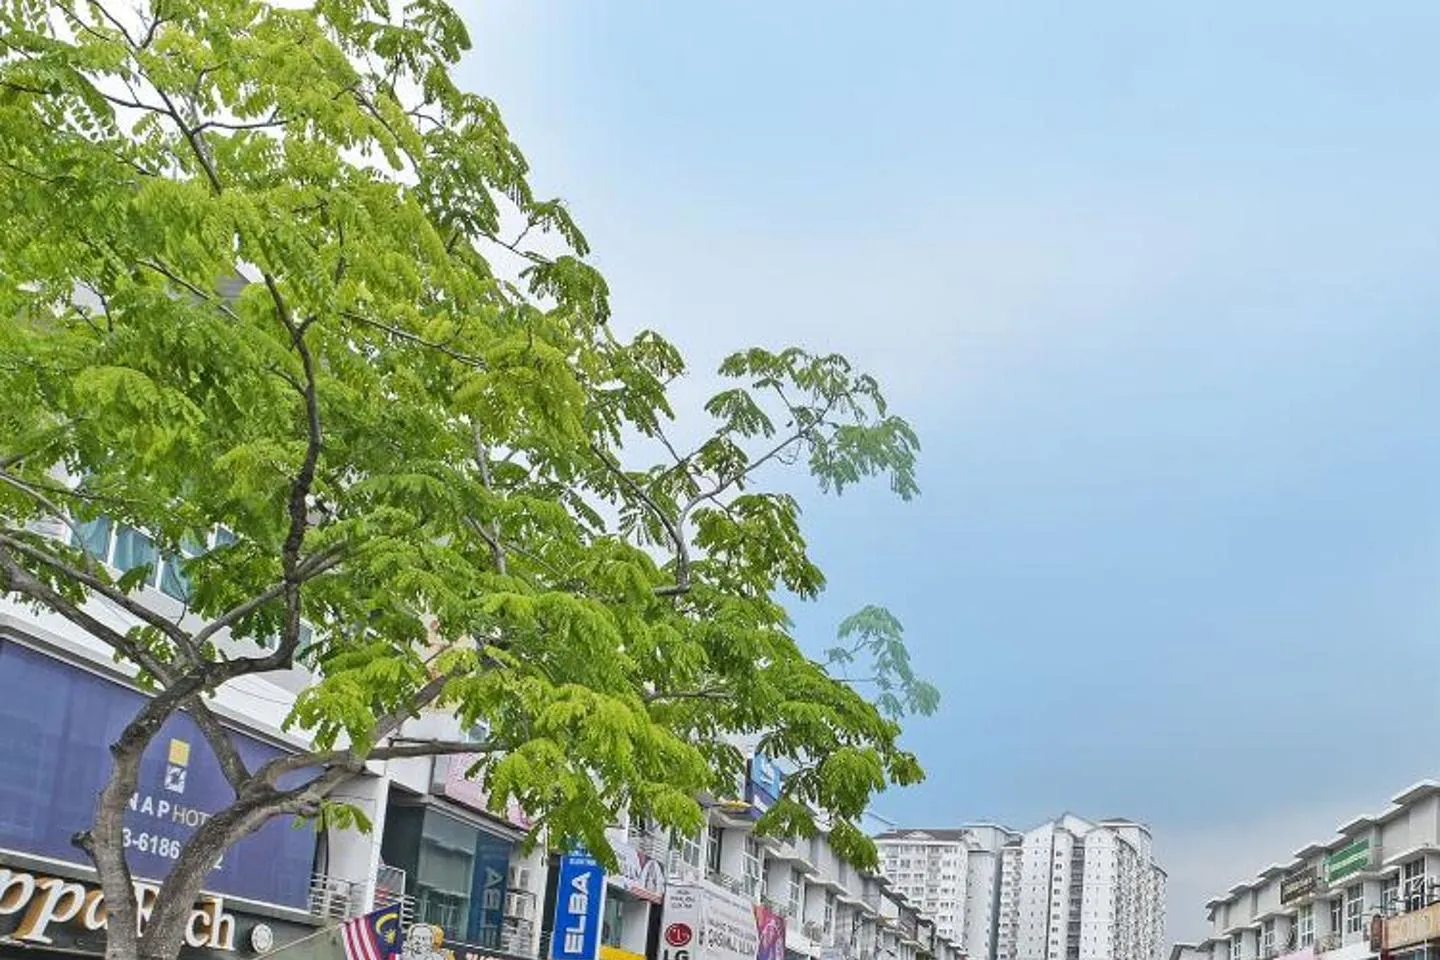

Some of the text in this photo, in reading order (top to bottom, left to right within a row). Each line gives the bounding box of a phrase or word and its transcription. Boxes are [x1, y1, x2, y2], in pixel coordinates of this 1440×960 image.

[129, 792, 211, 827] NAP HOT
[122, 826, 181, 859] 3-6186
[563, 870, 591, 953] ELBA
